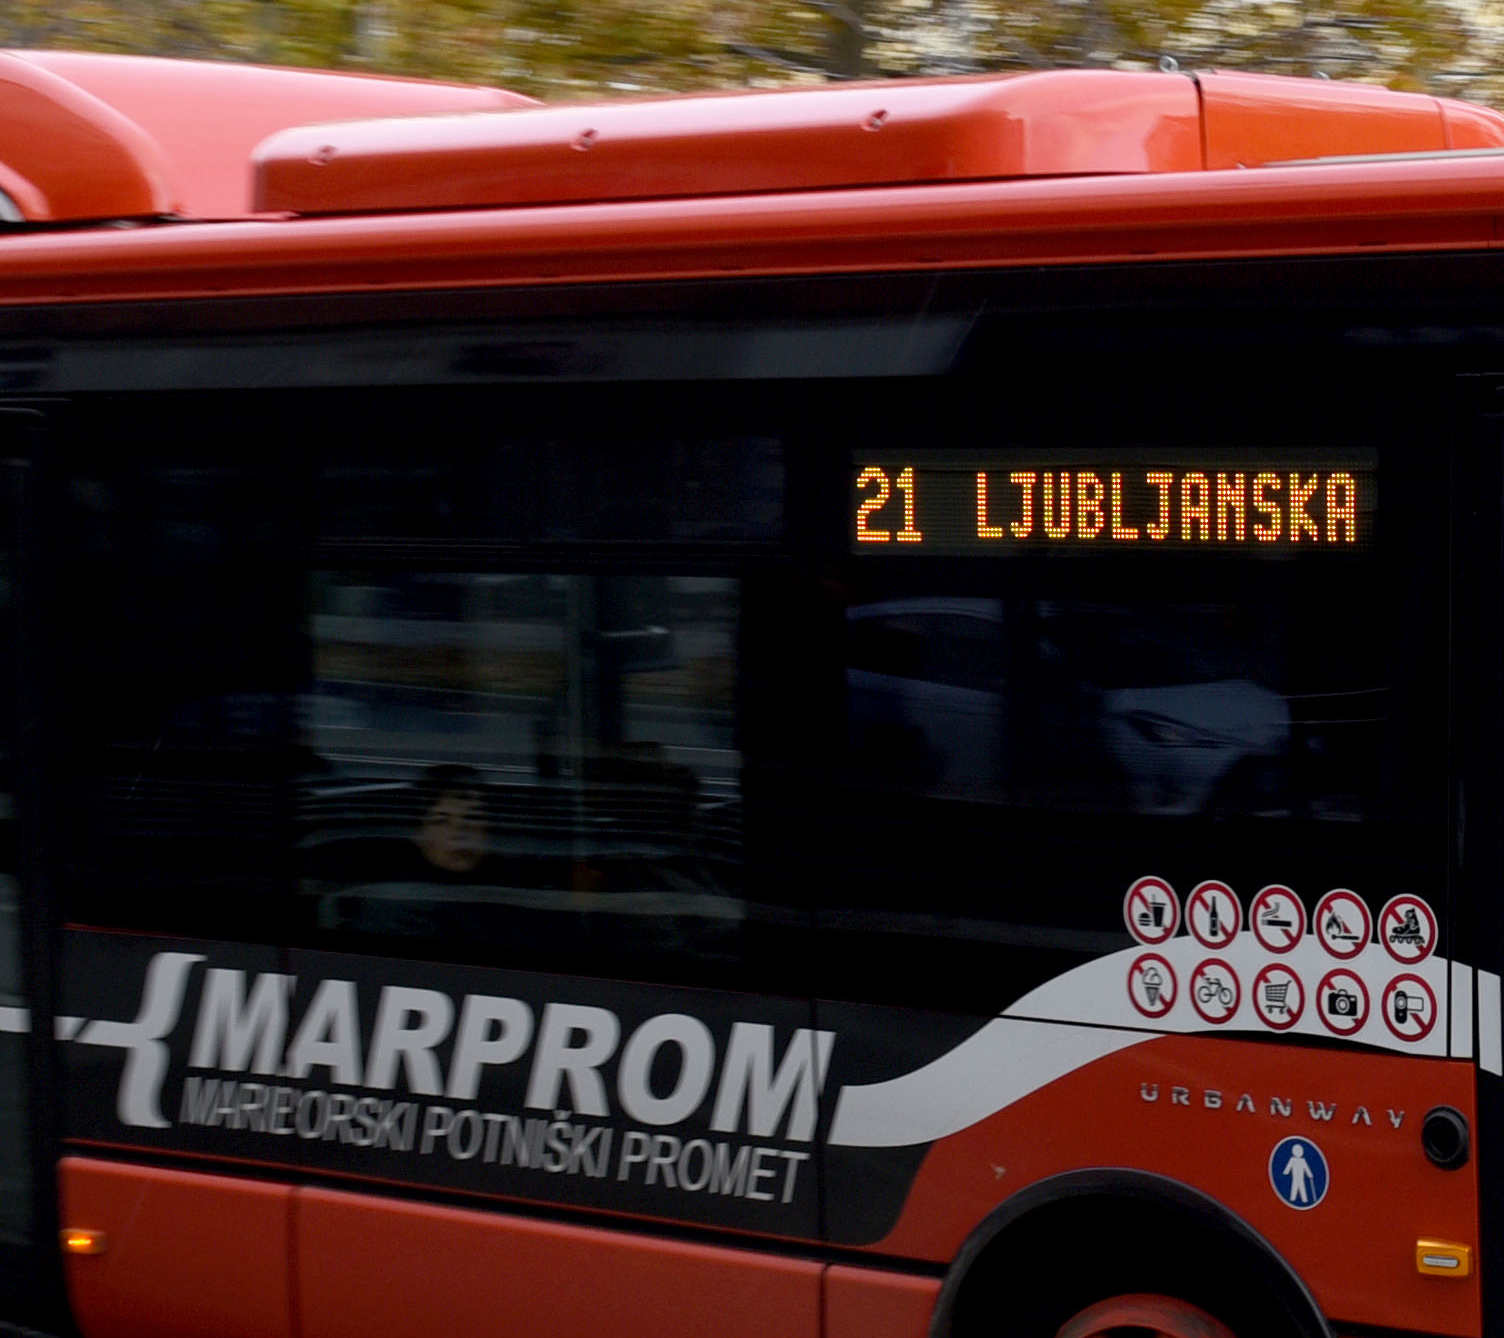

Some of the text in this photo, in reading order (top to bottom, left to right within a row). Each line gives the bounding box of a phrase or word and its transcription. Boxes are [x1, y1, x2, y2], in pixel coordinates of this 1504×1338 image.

[856, 466, 1357, 543] 21 LJUBLJANSKA
[188, 967, 837, 1142] MARPROM
[1139, 1082, 1405, 1129] URBANWAY
[179, 1075, 810, 1204] MARIBORSKI POTNIŠKI PROMET
